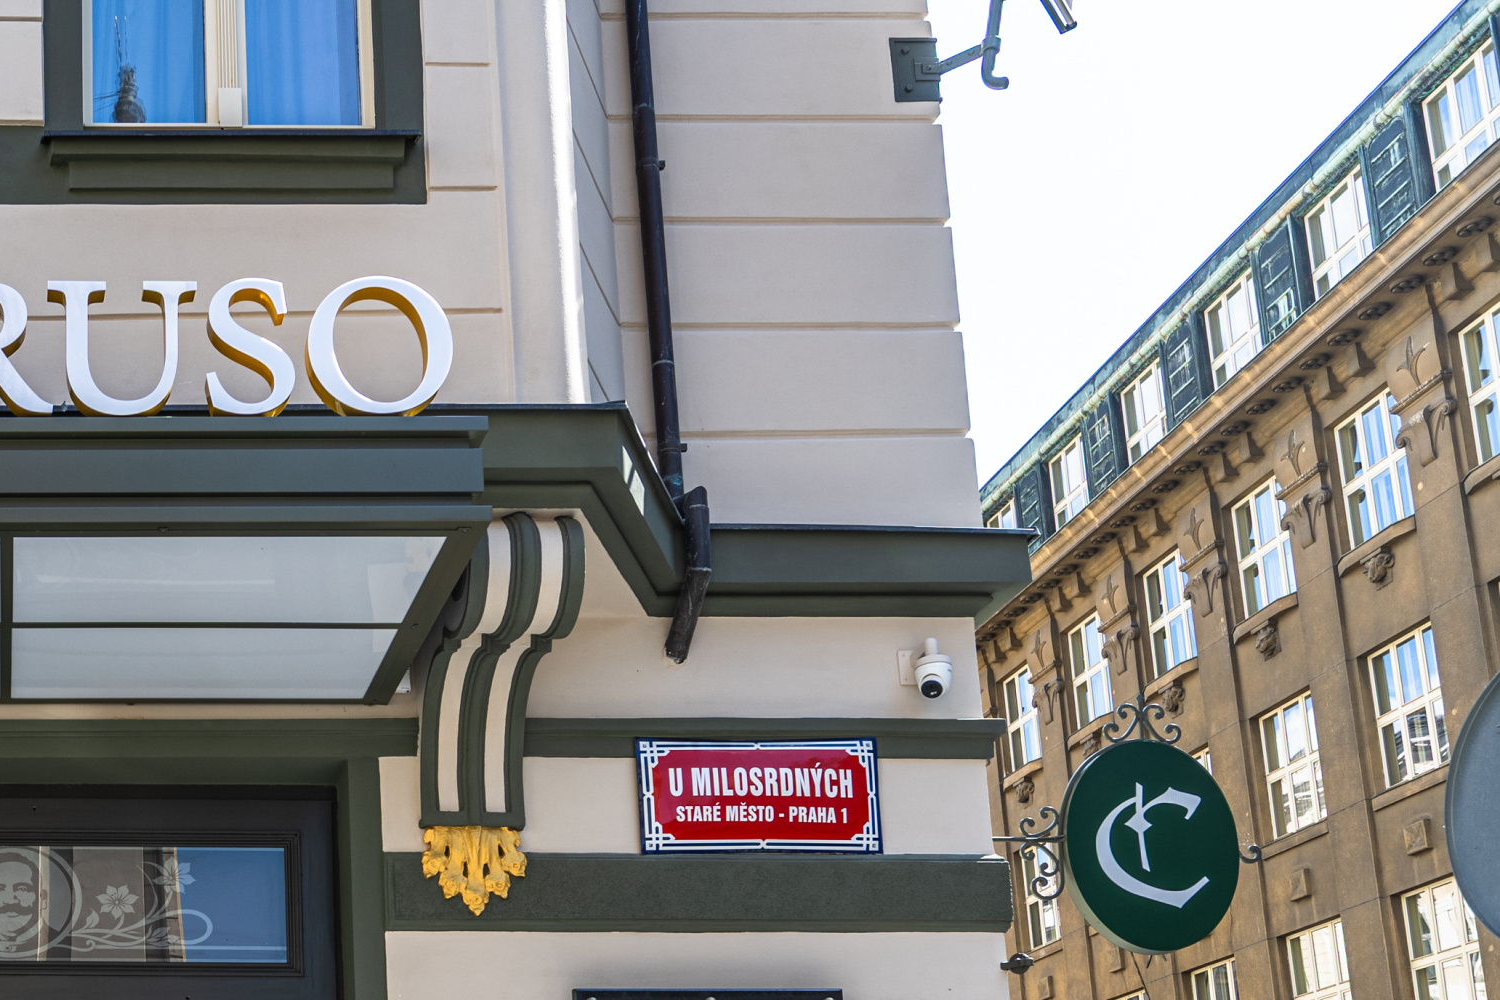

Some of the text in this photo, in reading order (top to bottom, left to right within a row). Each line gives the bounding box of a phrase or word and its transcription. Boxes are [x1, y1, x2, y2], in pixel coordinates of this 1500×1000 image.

[668, 762, 854, 798] U MILOSRDNÝCH
[676, 802, 722, 822] STARÉ
[726, 802, 774, 822] MĚSTO
[789, 806, 836, 824] PRAHA
[841, 807, 848, 824] 1
